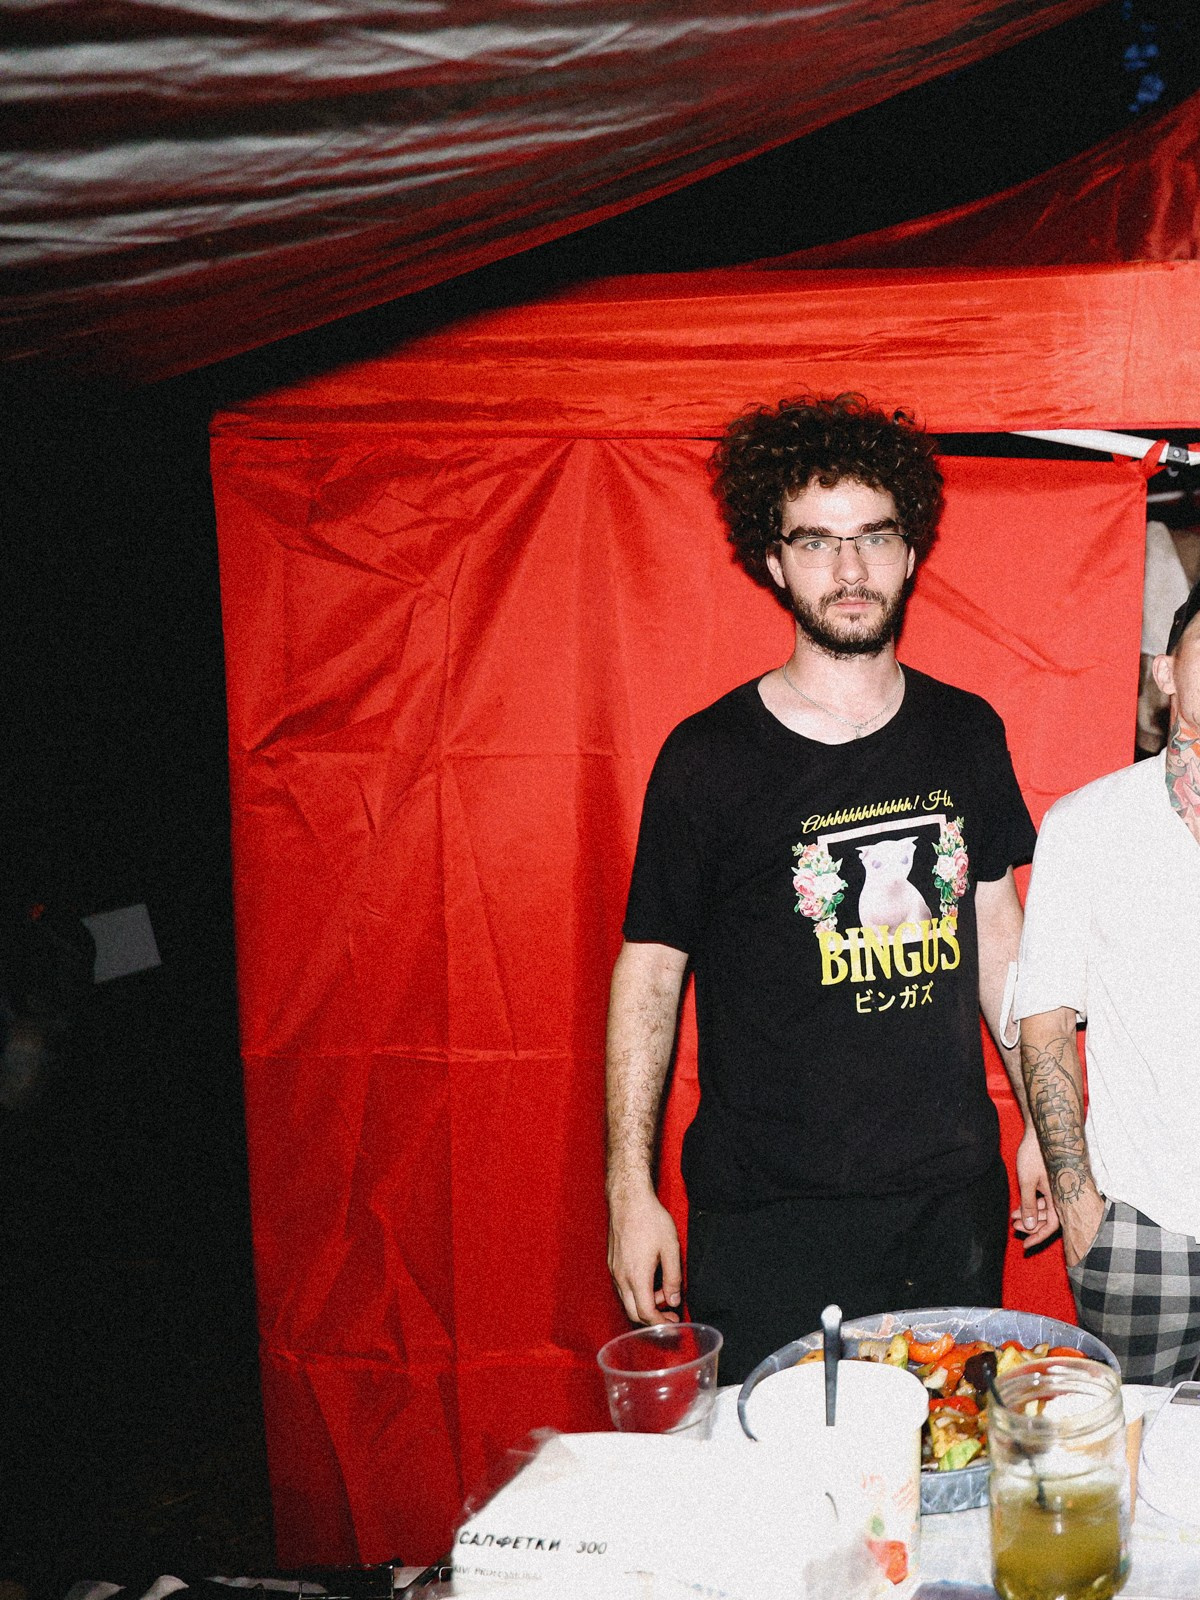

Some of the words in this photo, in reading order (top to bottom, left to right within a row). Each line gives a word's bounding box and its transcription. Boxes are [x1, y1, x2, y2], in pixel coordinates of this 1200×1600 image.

[816, 915, 961, 985] BINGUS
[459, 1531, 561, 1551] САЛФЕТКИ
[576, 1541, 608, 1554] 300
